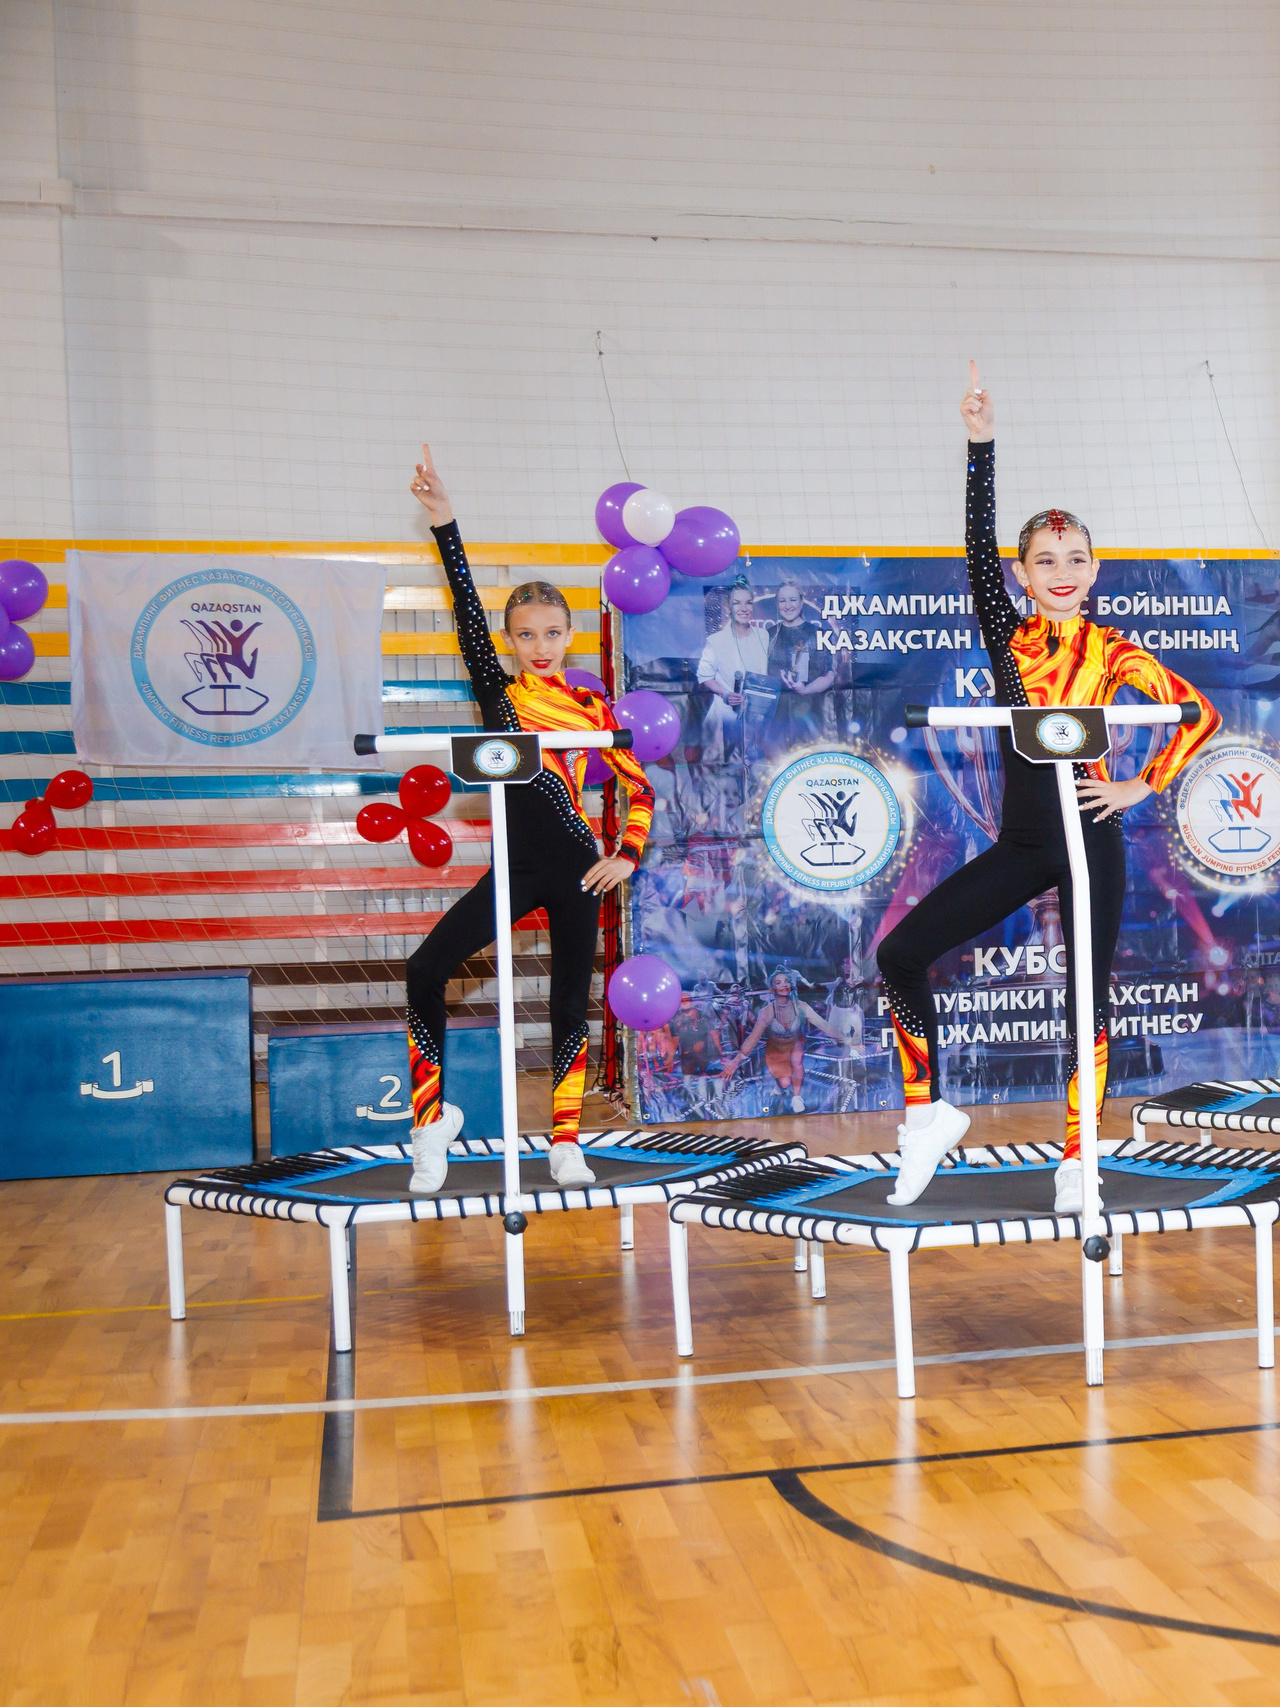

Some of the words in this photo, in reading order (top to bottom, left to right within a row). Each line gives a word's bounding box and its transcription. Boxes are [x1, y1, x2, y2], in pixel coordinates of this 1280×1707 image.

[160, 575, 200, 602] ФИТНЕС
[265, 585, 315, 662] РЕСПУБЛИКАСЫ
[191, 602, 262, 614] QAZAQSTAN
[1097, 591, 1232, 616] БОЙЫНША
[816, 629, 972, 654] ҚАЗАҚСТАН
[140, 680, 170, 720] JUMPING
[169, 716, 208, 742] FITNESS
[210, 730, 259, 744] REPUBLIC
[260, 720, 274, 735] OF
[786, 758, 817, 779] ФИТНЕС
[806, 778, 859, 787] QAZAQSTAN
[1180, 764, 1205, 810] ФЕДЕРАЦИЯ
[1204, 749, 1249, 767] ДЖАМПИНГ
[771, 845, 794, 873] JUMPING
[793, 868, 820, 887] FITNESS
[821, 879, 855, 888] REPUBLIC
[855, 874, 866, 882] OF
[865, 834, 896, 877] KAZAKHSTAN
[1182, 823, 1203, 855] RUSSIAN
[1202, 855, 1234, 872] JUMPING
[1235, 861, 1267, 873] FITNESS
[974, 945, 1067, 977] КУБО
[1110, 1013, 1204, 1038] ИТНЕСУ
[102, 1050, 122, 1087] 1
[379, 1074, 402, 1108] 2
